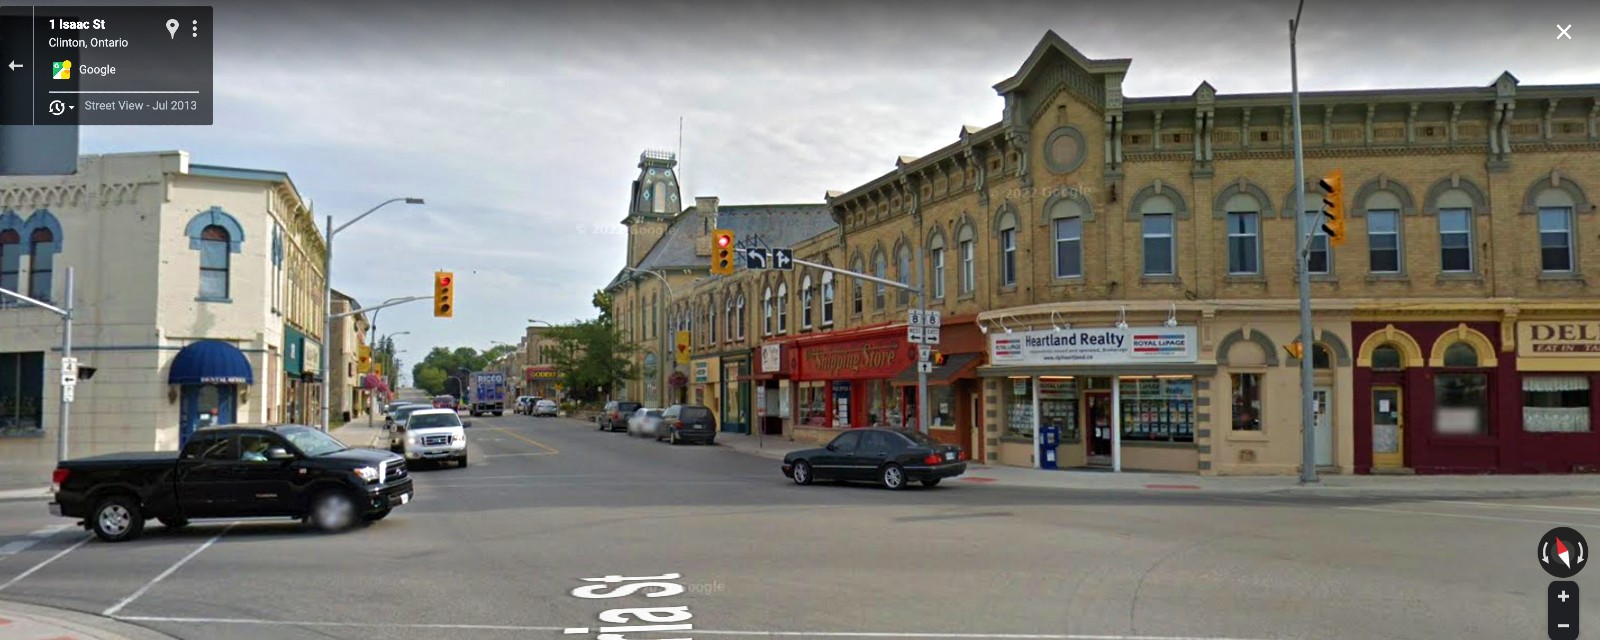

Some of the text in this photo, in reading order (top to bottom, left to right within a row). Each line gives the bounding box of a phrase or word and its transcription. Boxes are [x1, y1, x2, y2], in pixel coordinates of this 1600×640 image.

[912, 314, 919, 324] 8
[929, 315, 936, 325] 8
[1025, 331, 1125, 348] Heartland Realty
[1537, 344, 1557, 352] EAT
[1562, 344, 1575, 352] IN
[815, 350, 860, 377] Shipping
[862, 344, 896, 368] Store
